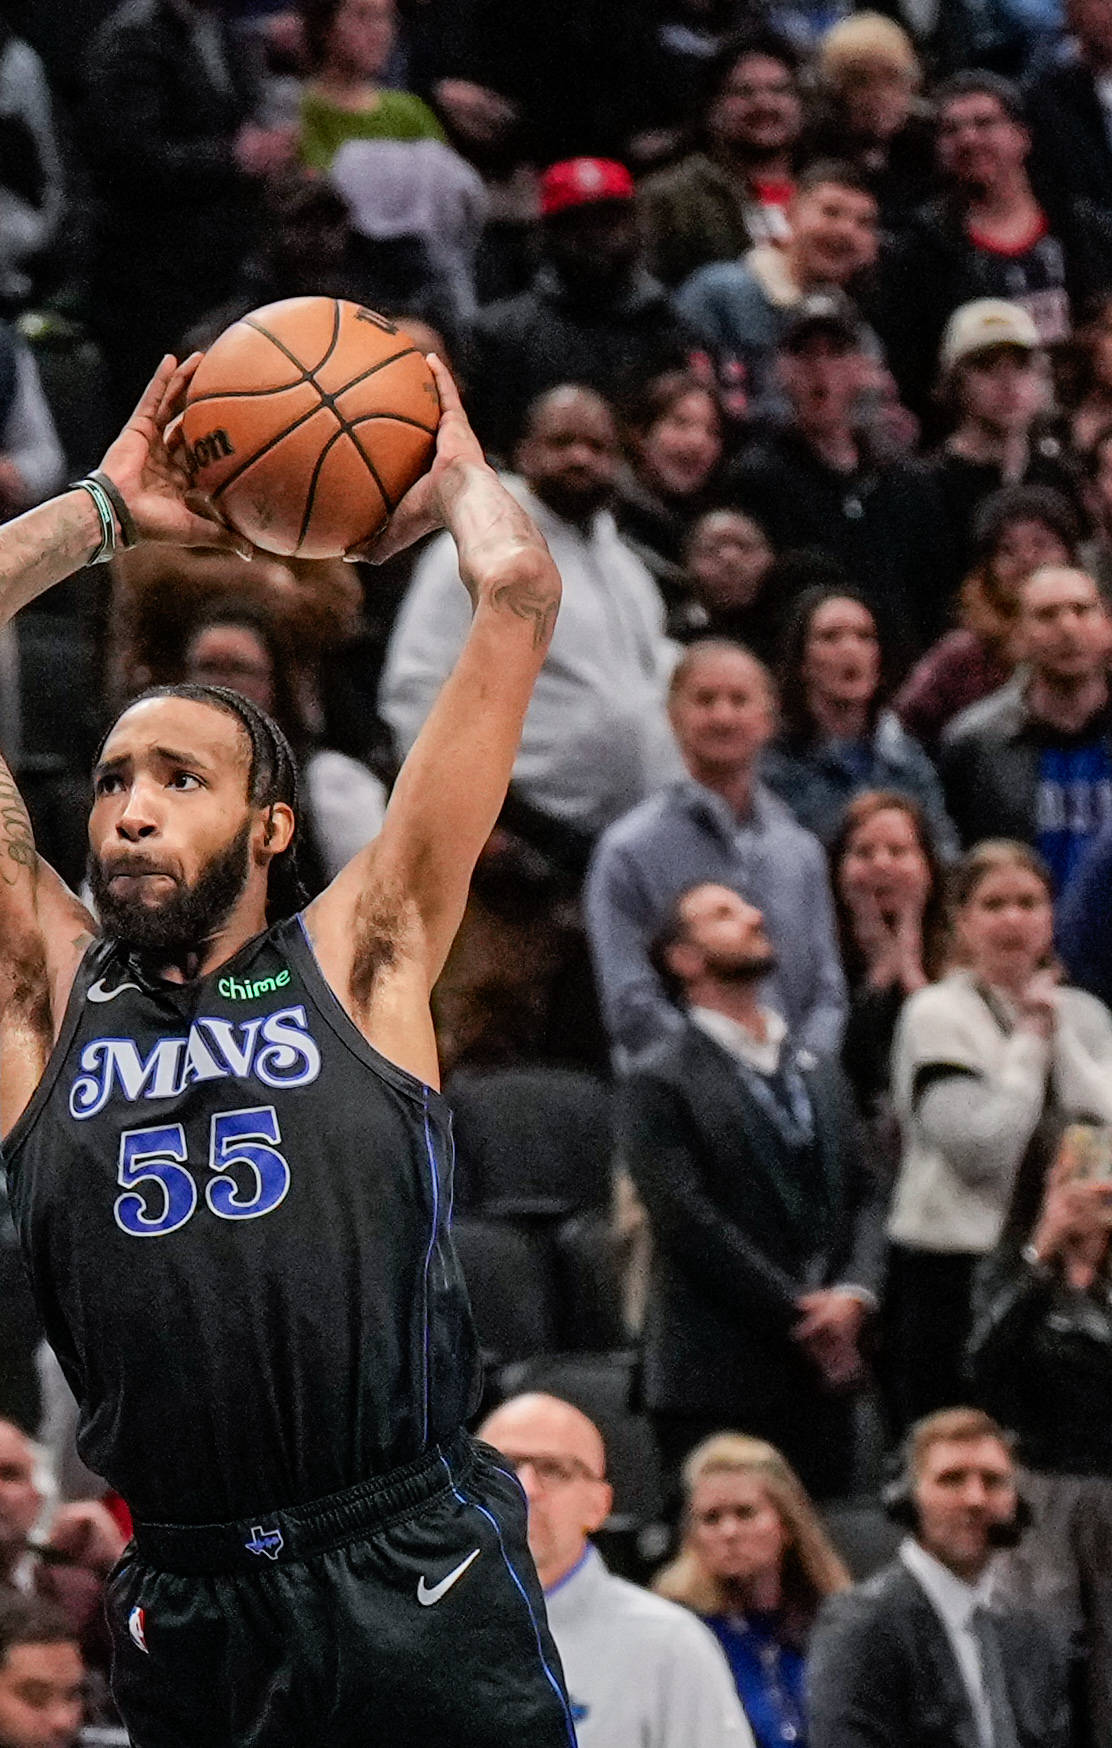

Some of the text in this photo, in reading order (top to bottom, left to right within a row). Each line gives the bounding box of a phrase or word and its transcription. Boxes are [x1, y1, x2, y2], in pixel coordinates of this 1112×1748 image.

[218, 969, 291, 1000] chime
[68, 1004, 321, 1120] MAVS
[113, 1105, 291, 1237] 55
